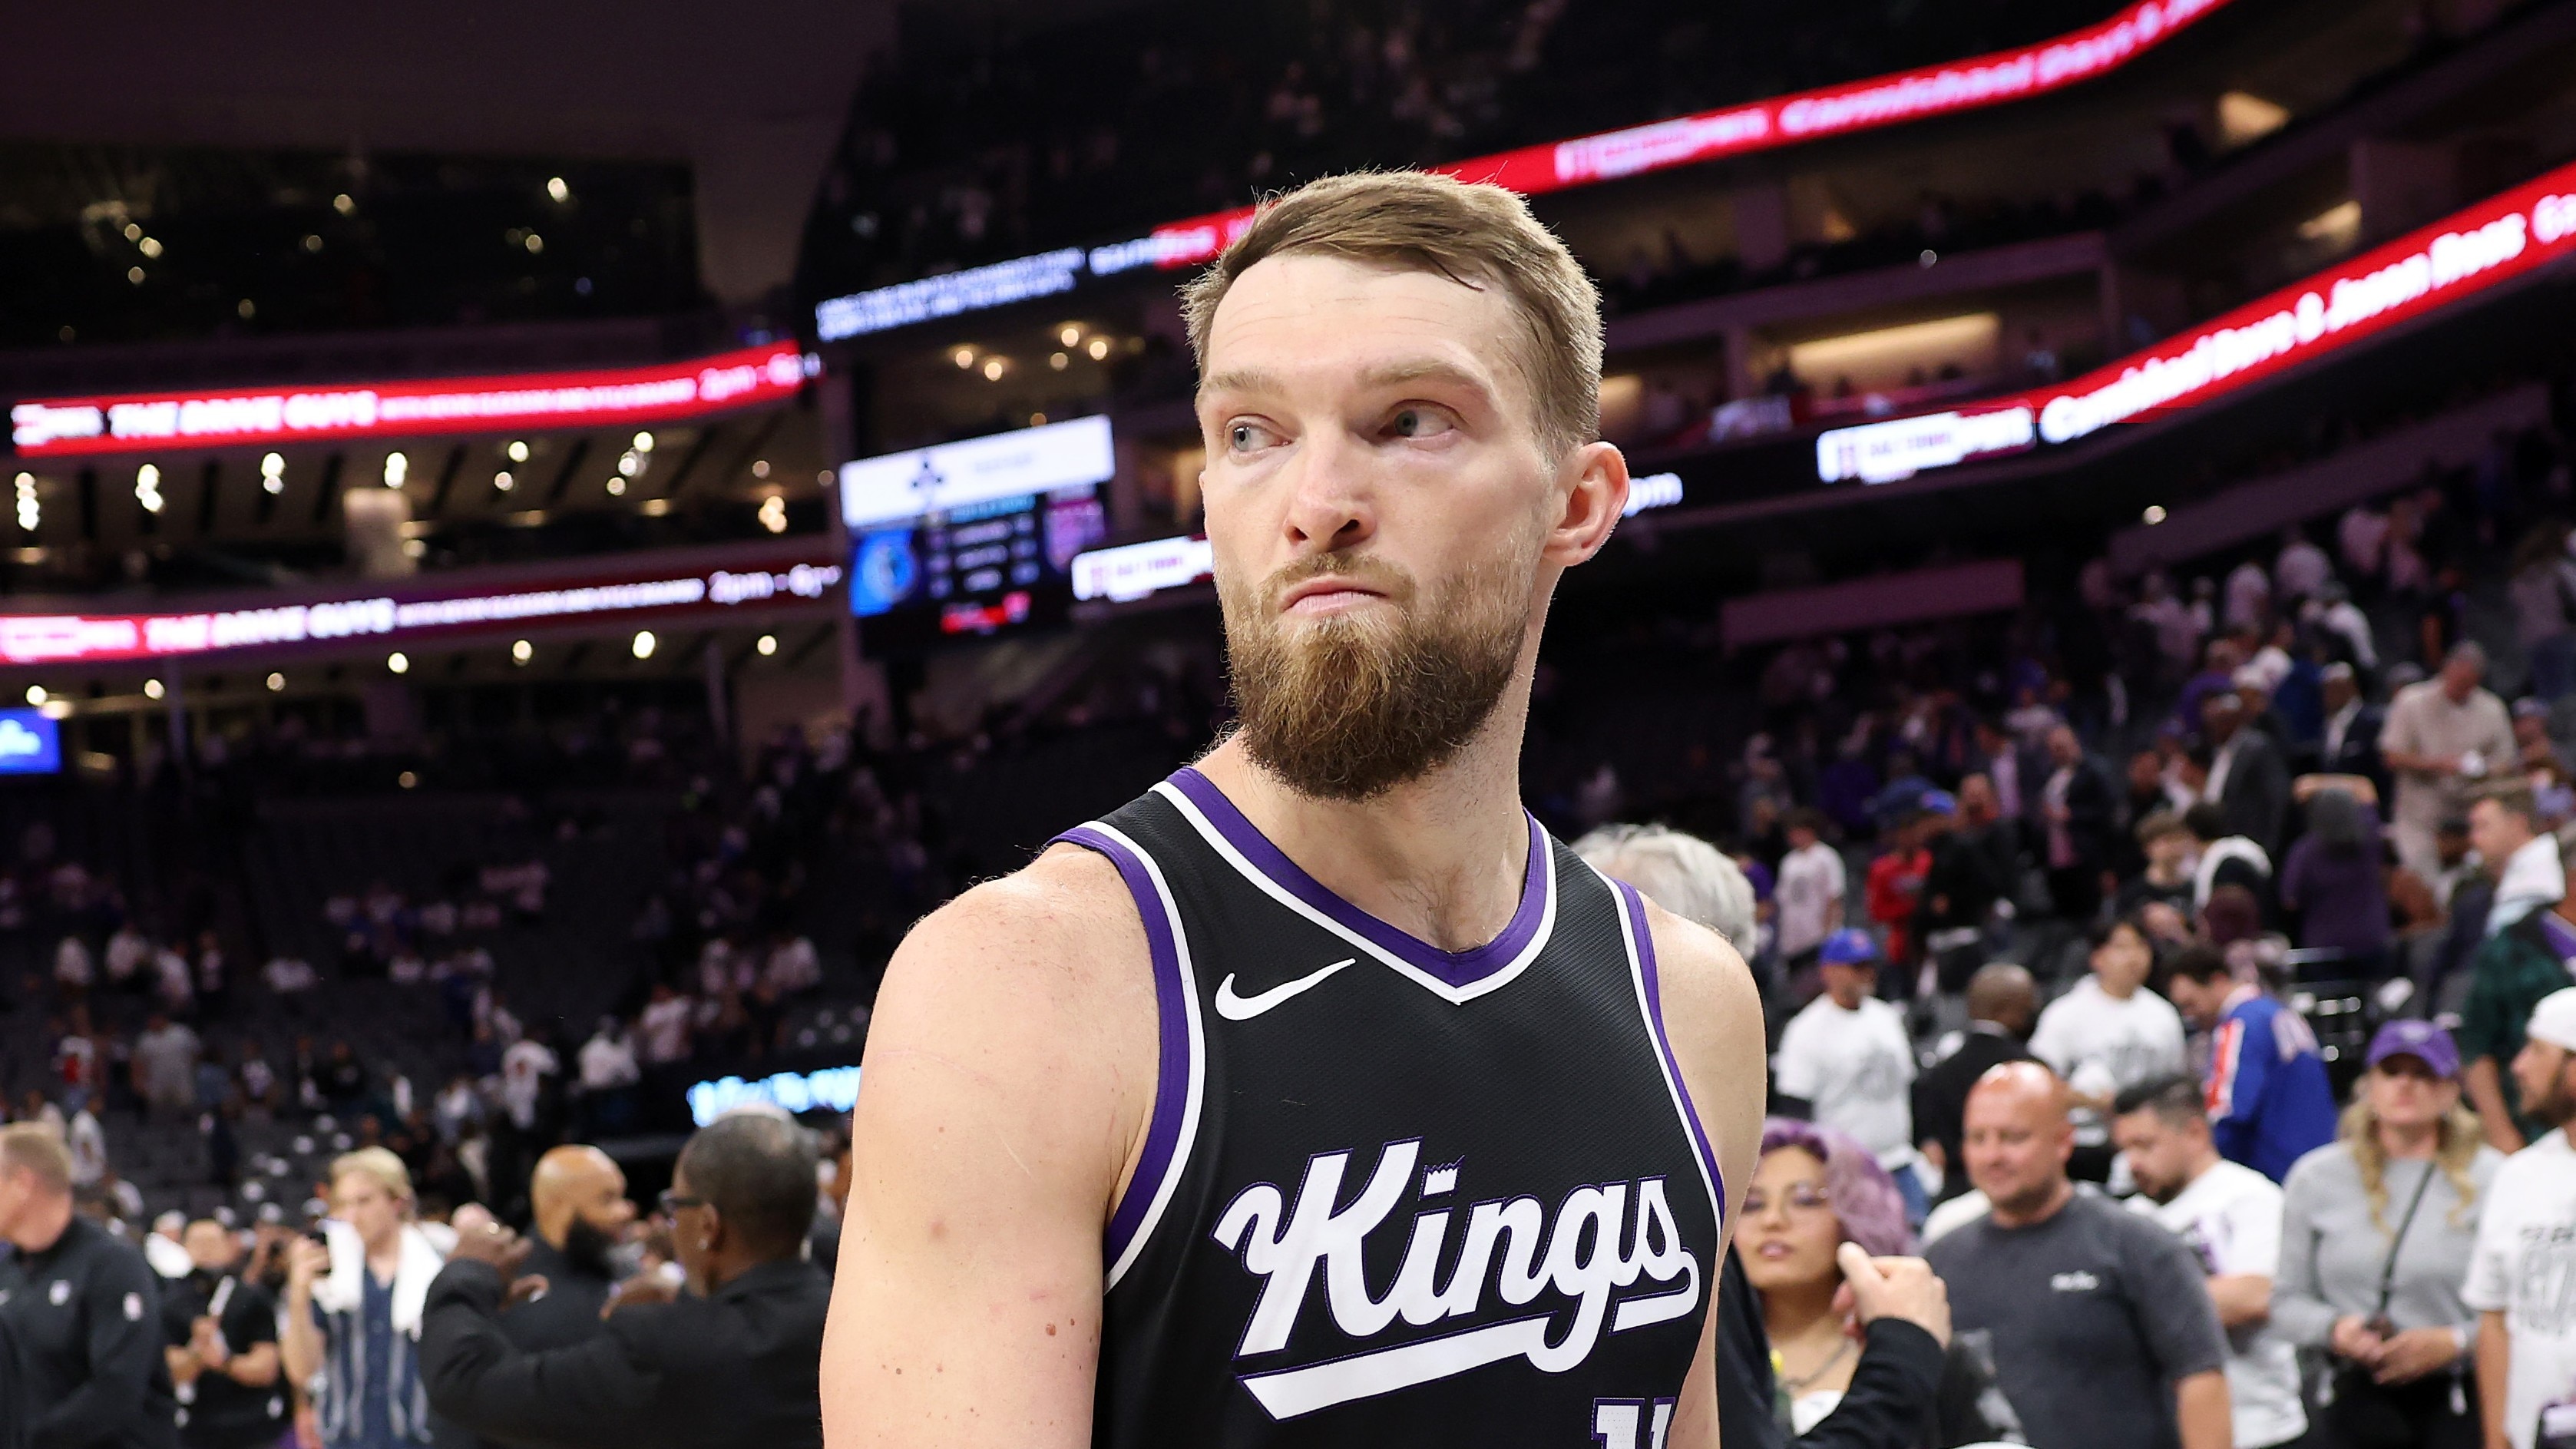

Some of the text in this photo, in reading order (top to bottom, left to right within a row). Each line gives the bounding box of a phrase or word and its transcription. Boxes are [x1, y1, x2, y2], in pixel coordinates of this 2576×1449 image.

[109, 402, 178, 438] THE
[283, 390, 378, 428] GUYS
[145, 614, 212, 652] THE
[308, 597, 396, 640] GUYS
[1211, 1137, 1699, 1421] Kings
